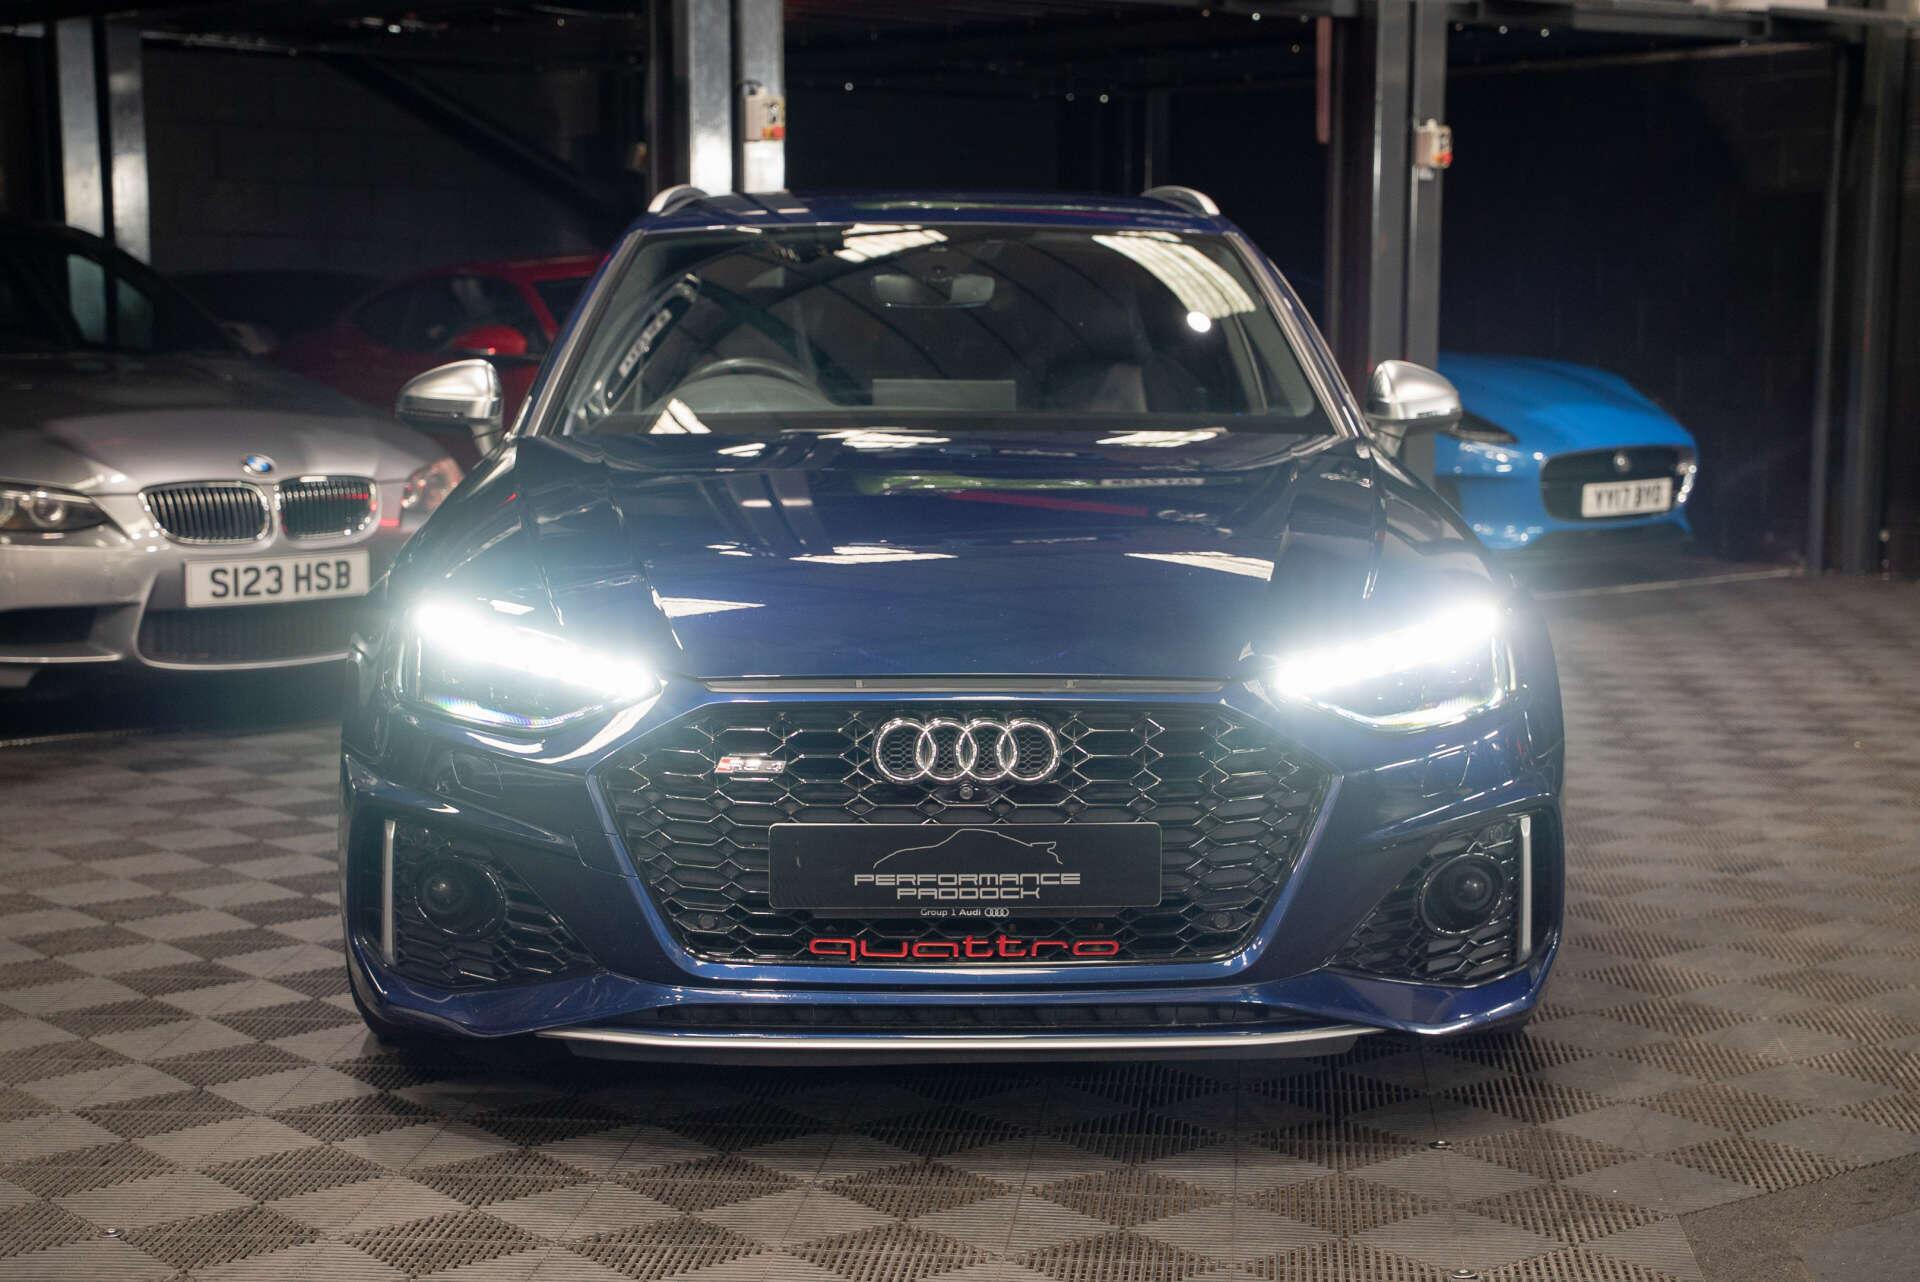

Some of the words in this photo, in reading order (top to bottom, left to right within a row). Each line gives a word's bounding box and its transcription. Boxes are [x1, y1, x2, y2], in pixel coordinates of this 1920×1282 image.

[210, 566, 283, 598] S123
[294, 560, 351, 593] HSB
[854, 873, 1081, 886] PERFORMANCE
[896, 887, 1040, 900] PADDOCK
[920, 908, 948, 918] Group
[959, 908, 981, 917] Audi
[809, 935, 1120, 961] quattro
